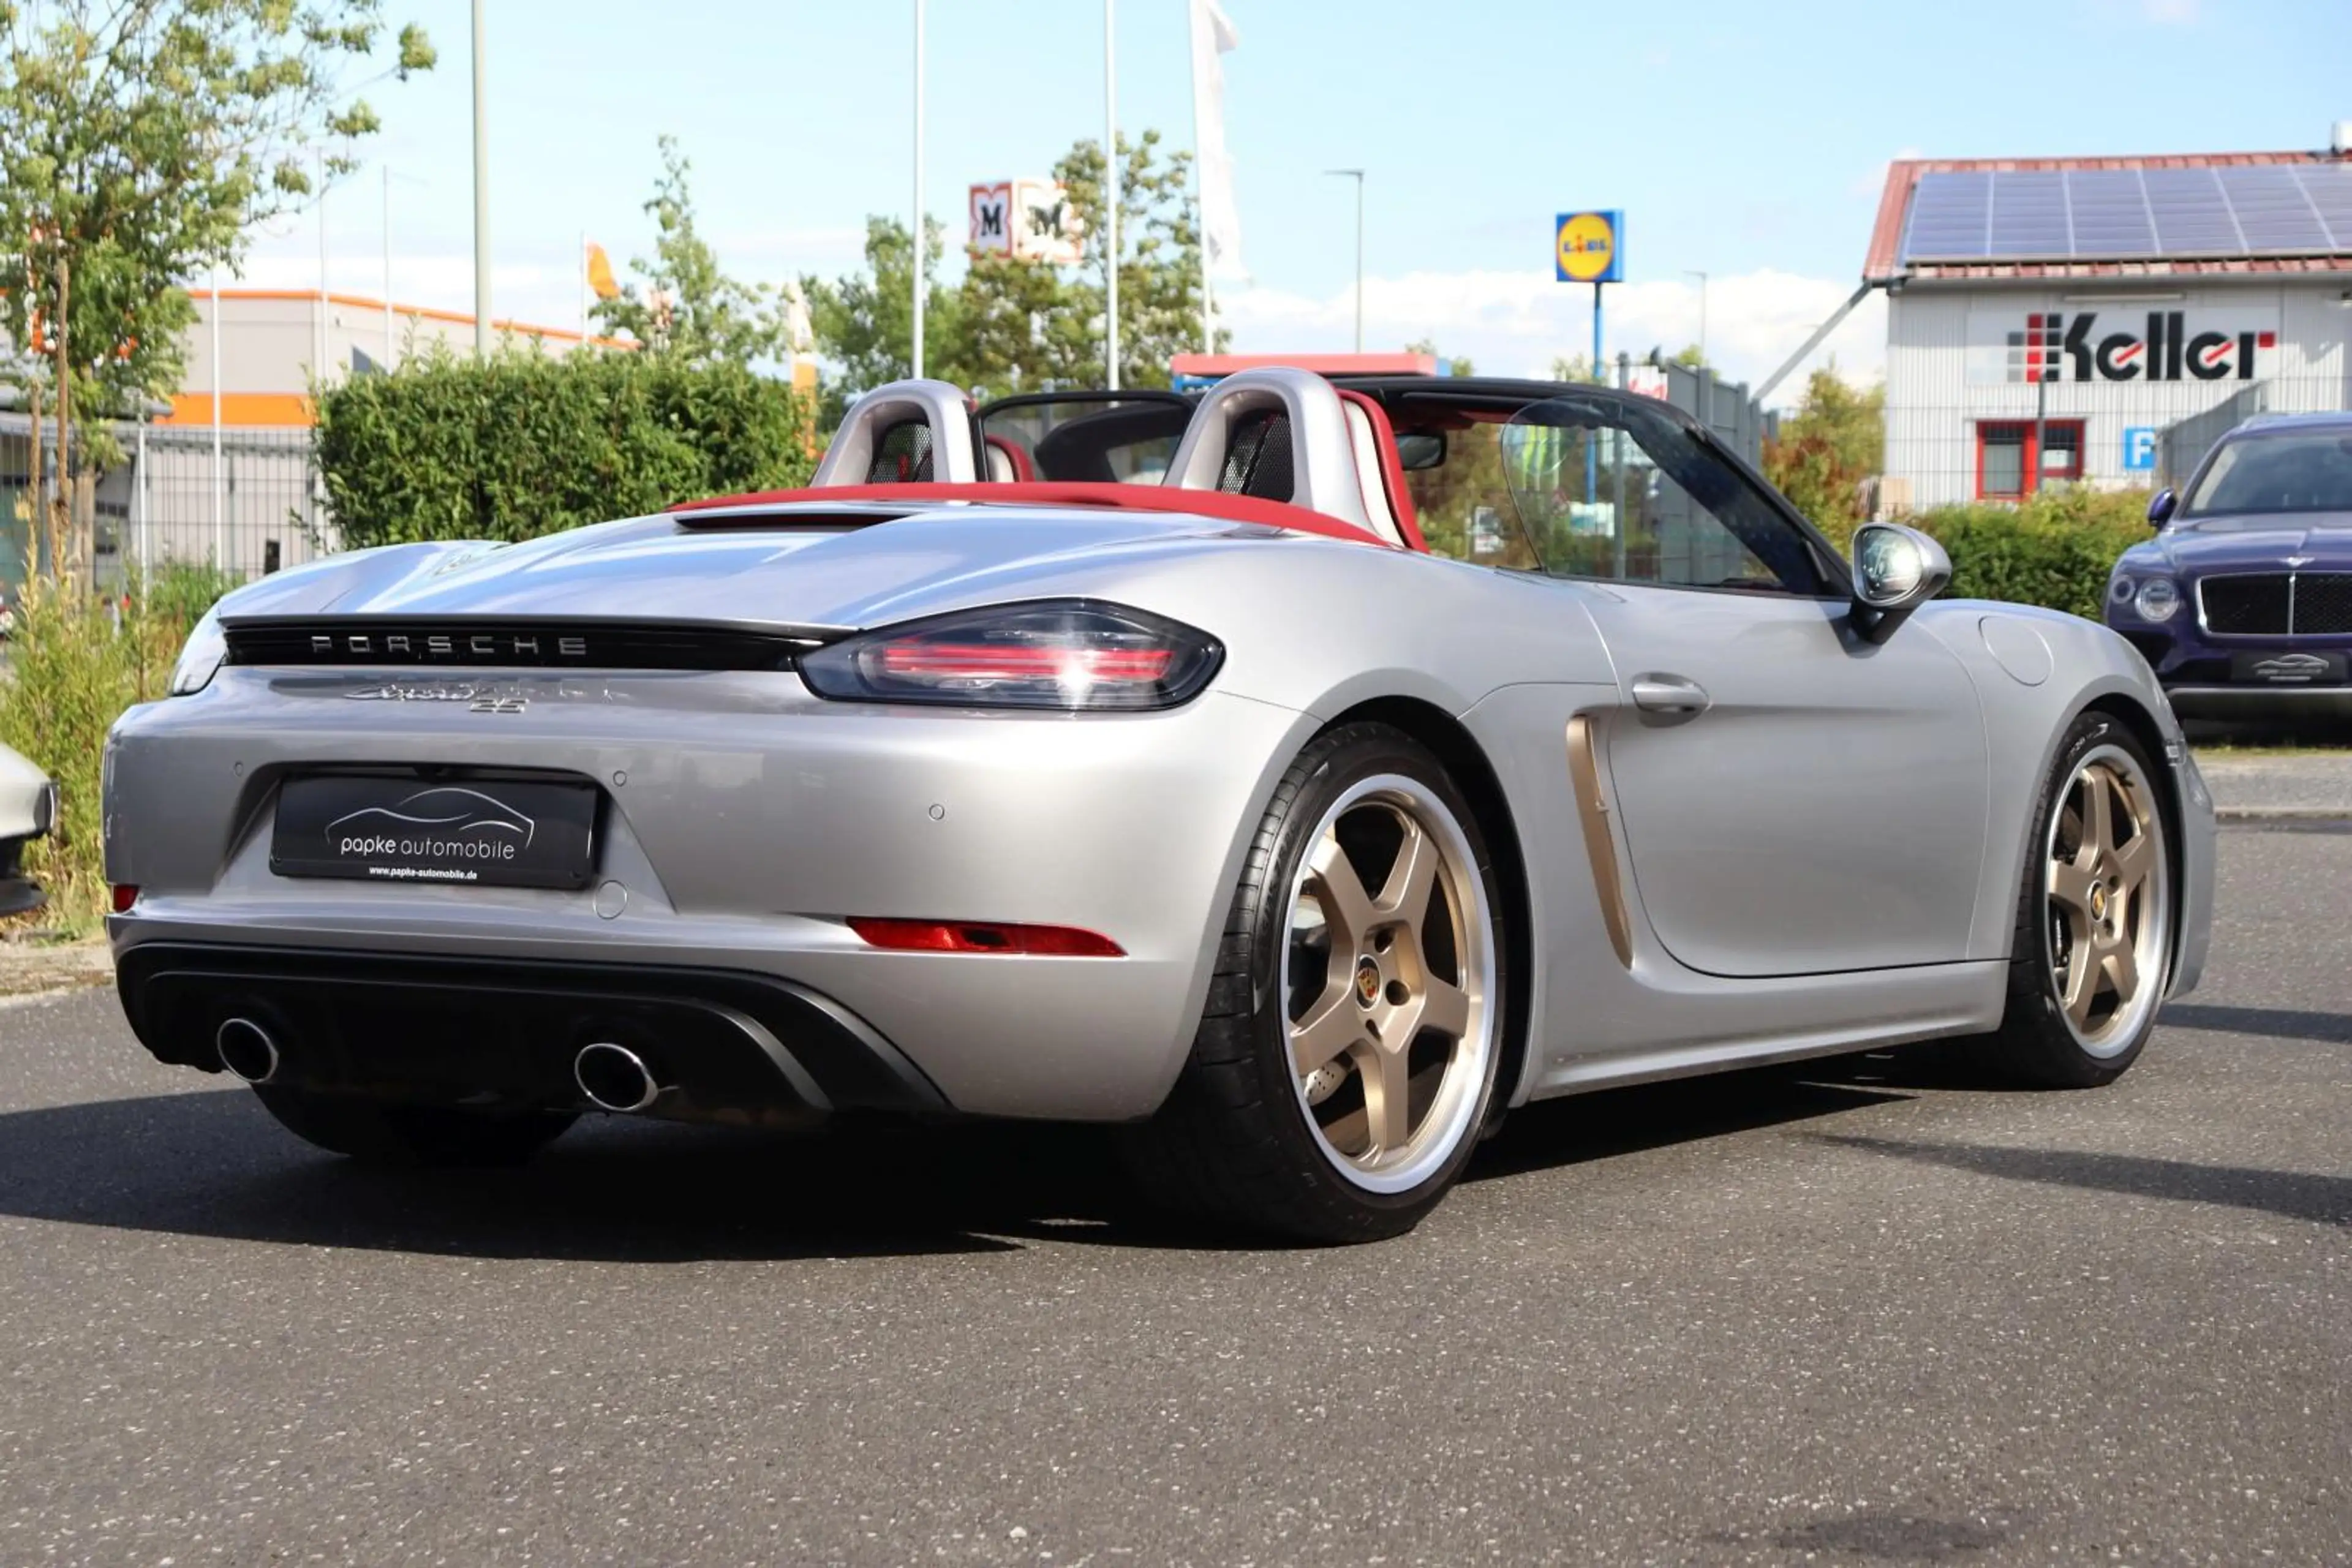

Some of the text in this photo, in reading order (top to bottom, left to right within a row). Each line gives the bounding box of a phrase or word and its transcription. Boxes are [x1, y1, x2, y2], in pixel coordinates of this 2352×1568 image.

[981, 203, 1001, 236] M
[2045, 311, 2275, 381] Keller
[312, 636, 586, 655] PORSCHE
[341, 835, 514, 859] papke automobile
[369, 866, 477, 880] www.papke-automobile.de
